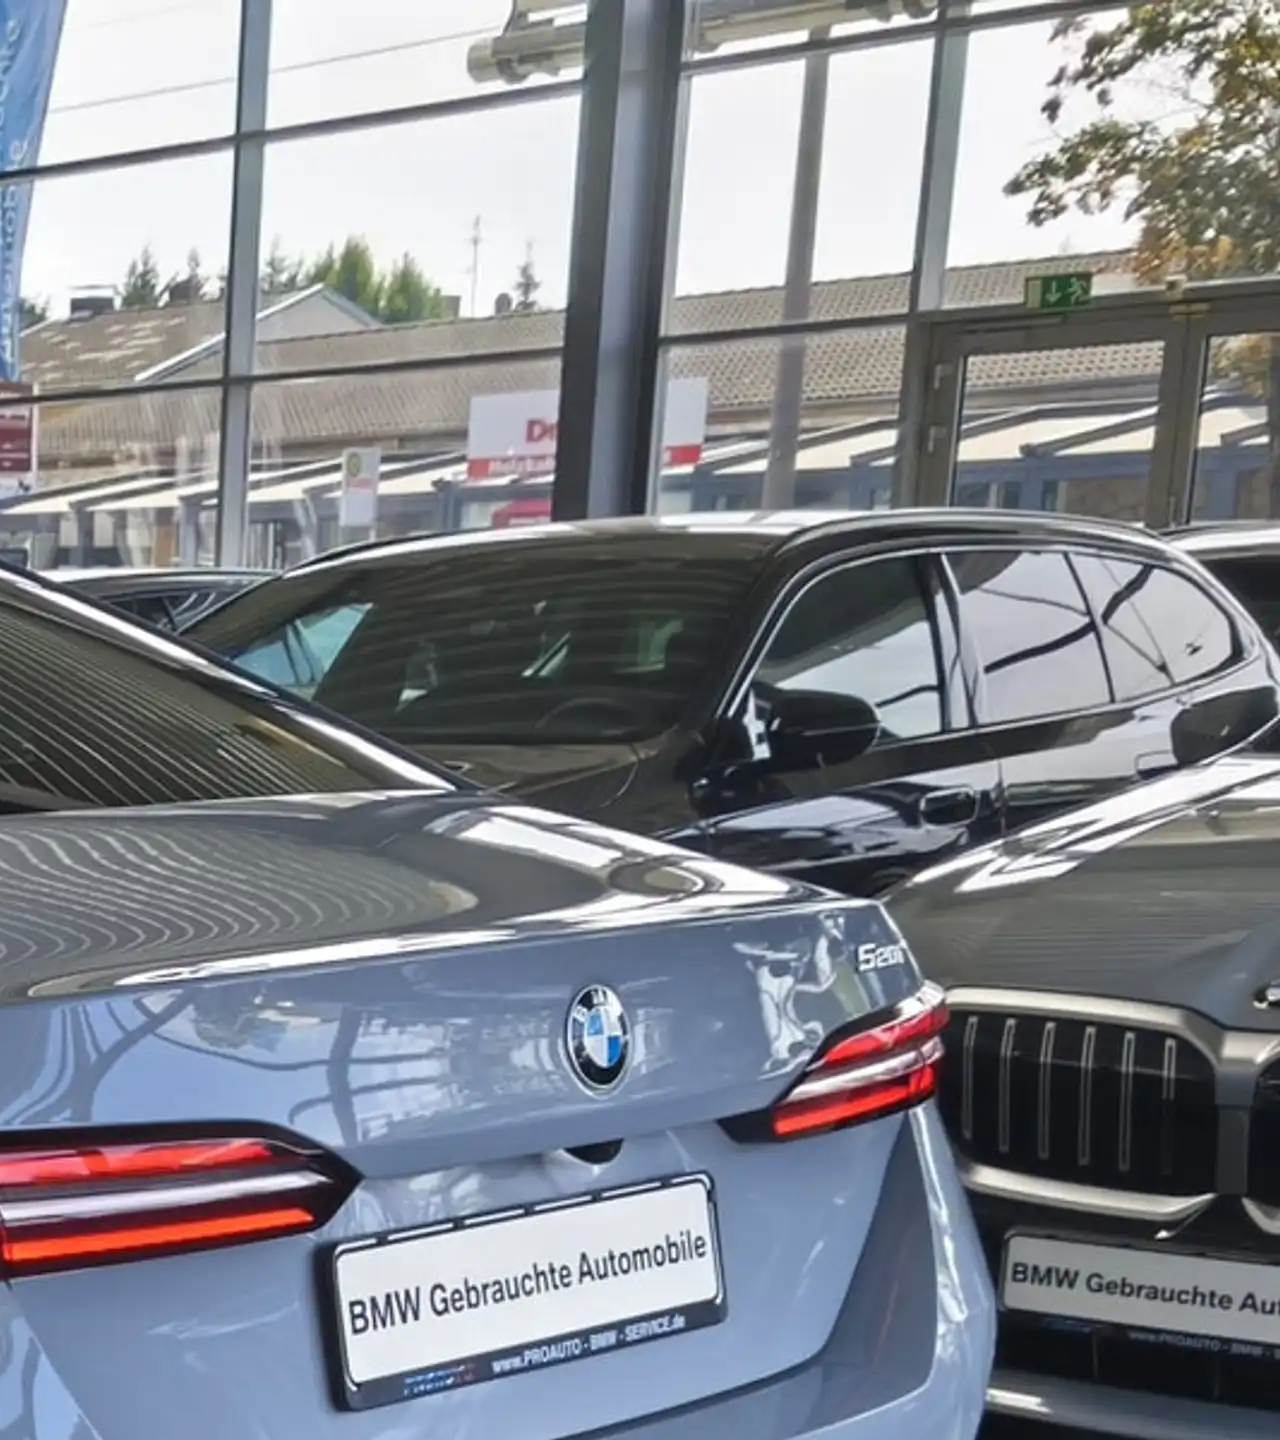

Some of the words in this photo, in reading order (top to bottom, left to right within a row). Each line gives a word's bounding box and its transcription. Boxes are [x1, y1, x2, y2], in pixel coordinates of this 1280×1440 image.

[349, 1287, 421, 1334] BMW
[430, 1262, 572, 1316] Gebrauchte
[578, 1230, 706, 1283] Automobile
[1011, 1261, 1080, 1290] BMW
[1085, 1272, 1234, 1311] Gebrauchte
